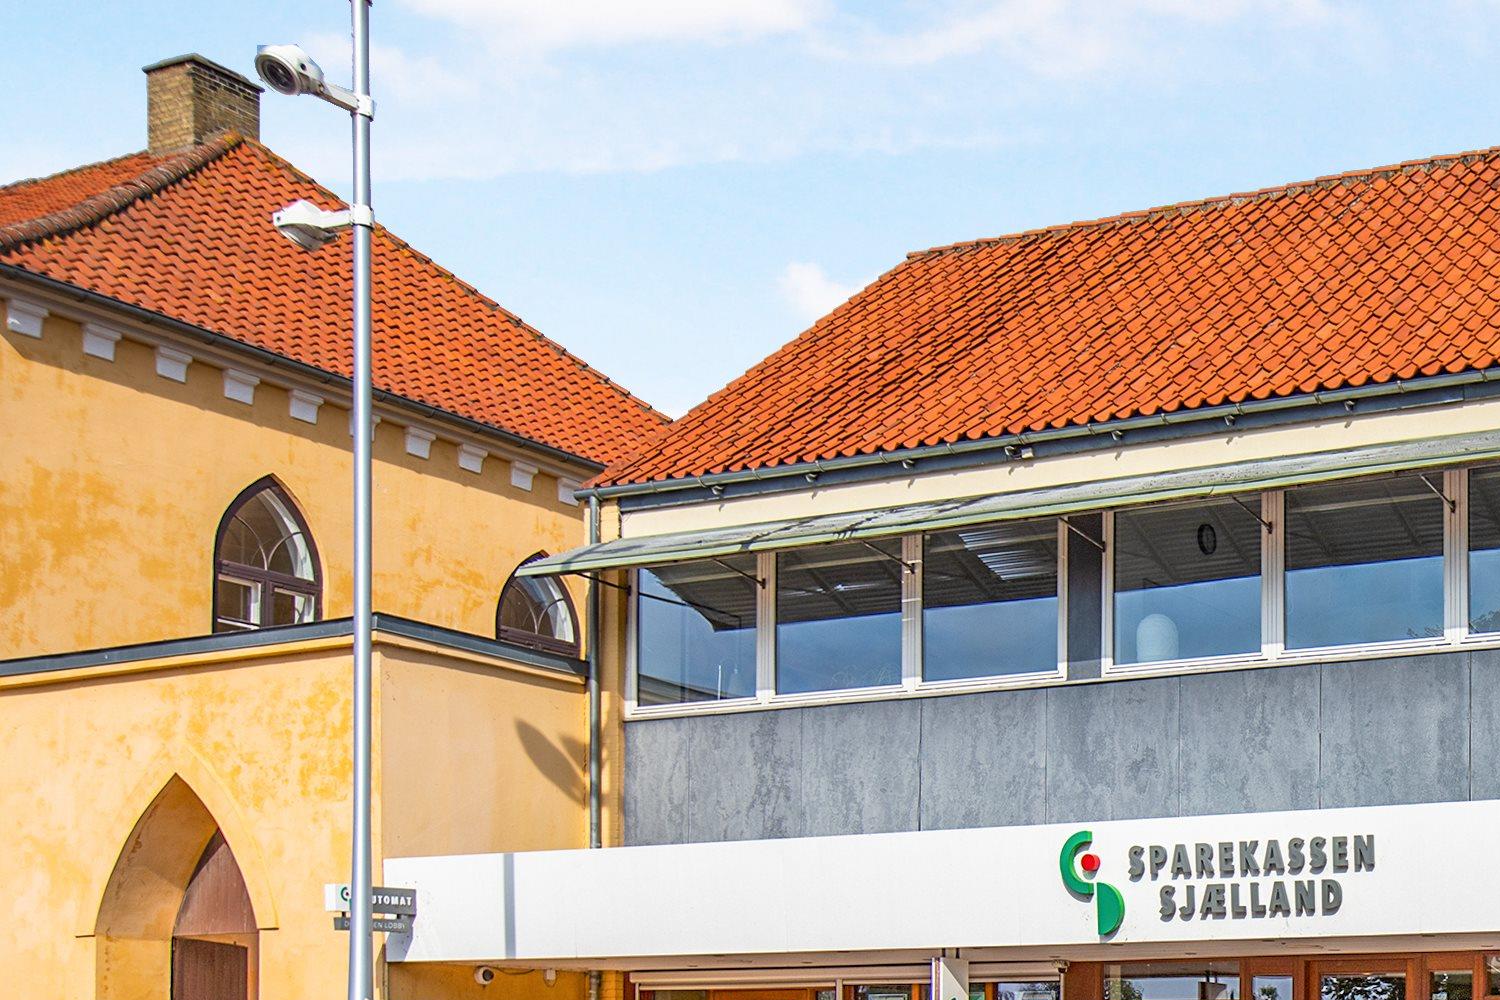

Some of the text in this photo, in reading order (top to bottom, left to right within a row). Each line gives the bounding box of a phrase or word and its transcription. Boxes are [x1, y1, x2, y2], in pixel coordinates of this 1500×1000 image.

[1128, 834, 1375, 882] SPAREKASSEN
[371, 894, 412, 906] UTOMAT
[1159, 879, 1343, 922] SJÆLLAND
[384, 922, 405, 930] LOBBY
